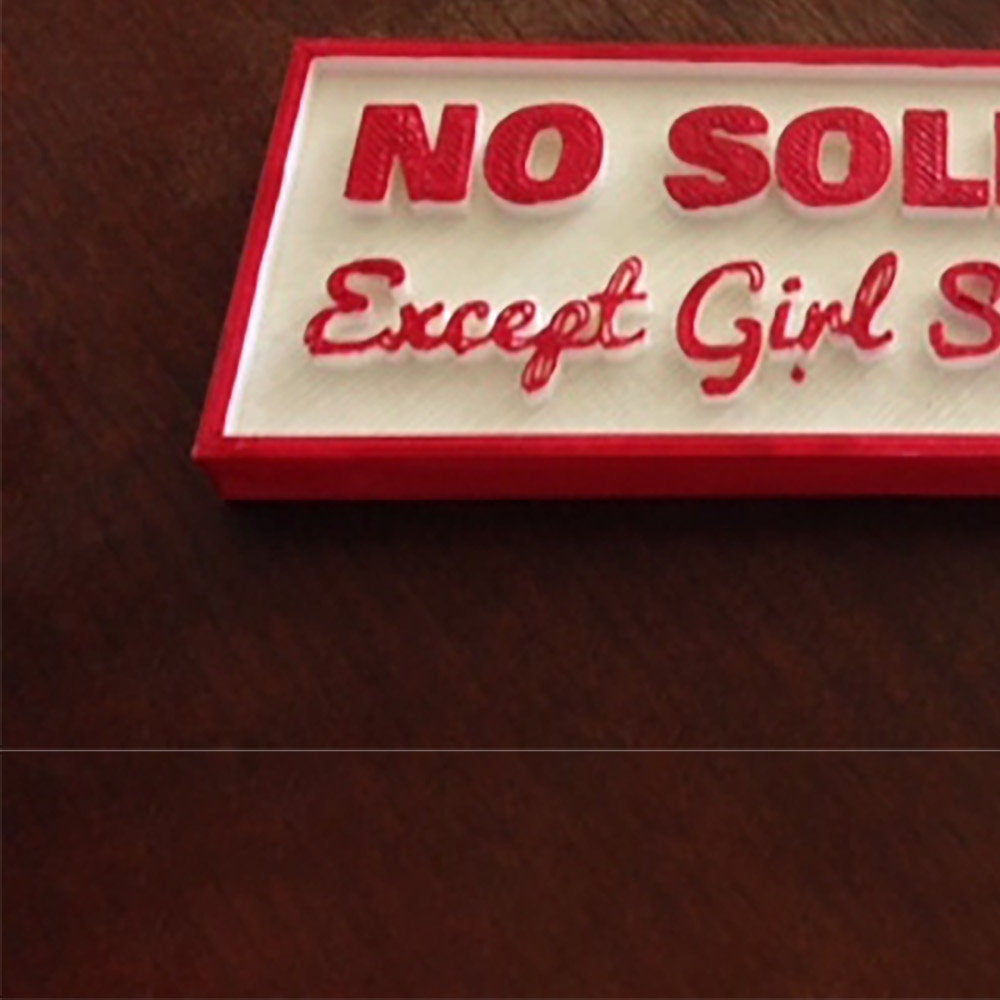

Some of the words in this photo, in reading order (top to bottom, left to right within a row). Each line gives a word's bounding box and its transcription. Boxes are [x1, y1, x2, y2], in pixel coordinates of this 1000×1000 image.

[344, 103, 605, 208] NO
[304, 256, 649, 395] Except
[676, 252, 900, 399] Girl
